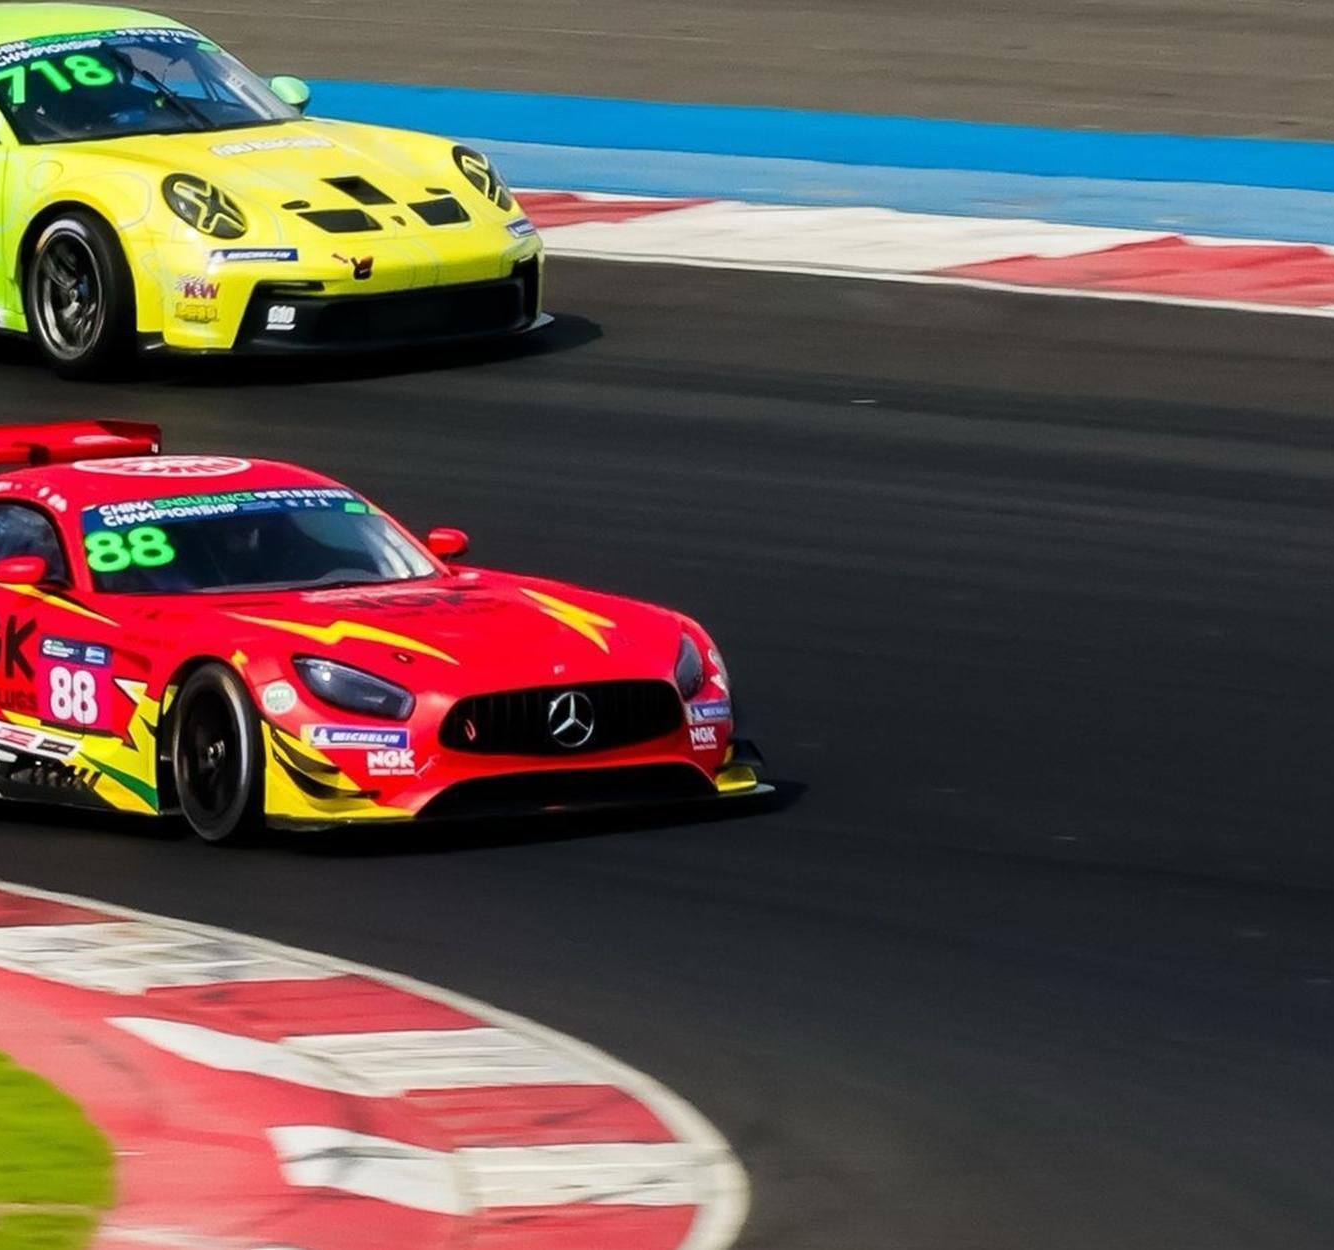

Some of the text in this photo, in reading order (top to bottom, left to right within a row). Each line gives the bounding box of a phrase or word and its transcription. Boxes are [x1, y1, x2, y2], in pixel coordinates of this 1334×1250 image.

[98, 499, 155, 517] CHINA
[154, 491, 256, 510] ENDURANCE
[103, 503, 238, 528] CHAMPIONSHIP
[85, 526, 175, 572] 88
[49, 665, 99, 725] 88
[331, 731, 401, 744] MICHELIN
[689, 726, 717, 744] NGK
[367, 750, 416, 769] NGK
